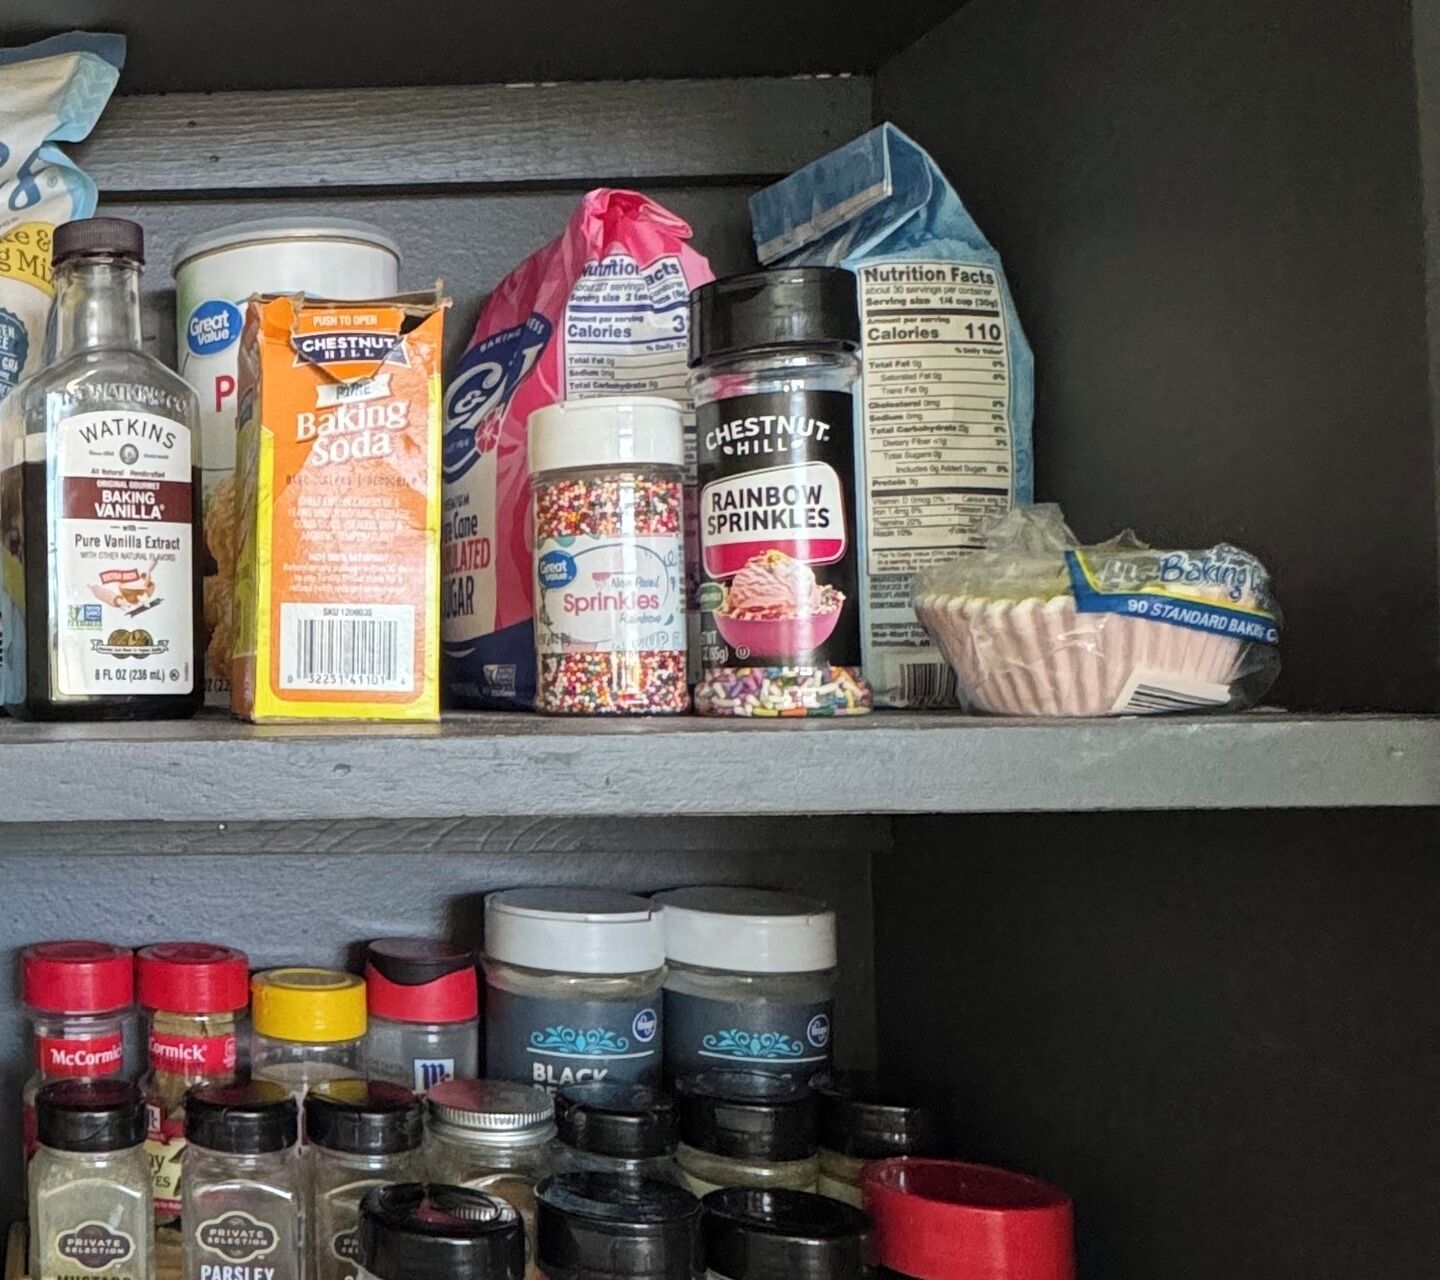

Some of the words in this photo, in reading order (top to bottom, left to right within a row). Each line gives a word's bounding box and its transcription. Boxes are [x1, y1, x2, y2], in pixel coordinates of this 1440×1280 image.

[36, 230, 51, 252] &
[864, 267, 945, 282] Nutrition
[951, 267, 994, 285] Facts
[190, 310, 230, 336] Great
[313, 315, 337, 326] PUSH
[340, 315, 351, 326] TO
[353, 315, 377, 326] OPEN
[568, 324, 631, 338] Calories
[197, 326, 230, 347] Value
[868, 326, 939, 341] Calories
[965, 322, 1001, 341] 110
[302, 337, 395, 353] CHESTNUT
[324, 348, 375, 360] HILL
[296, 400, 409, 443] Baking
[79, 418, 176, 449] WATKINS
[706, 415, 831, 451] CHESTNUT
[311, 431, 392, 466] Soda
[736, 439, 788, 456] HILL
[102, 490, 155, 504] BAKING
[712, 484, 823, 512] RAINBOW
[95, 504, 162, 519] VANILLA
[708, 507, 830, 535] SPRINKLES
[75, 534, 100, 547] Pure
[104, 534, 141, 548] Vanilla
[145, 536, 180, 550] Extract
[563, 592, 659, 617] Sprinkles
[1128, 599, 1148, 614] 90
[1150, 604, 1227, 630] STANDARD
[51, 1044, 122, 1066] McCormic
[532, 1062, 610, 1084] BLACK
[67, 1238, 120, 1247] PRIVATE
